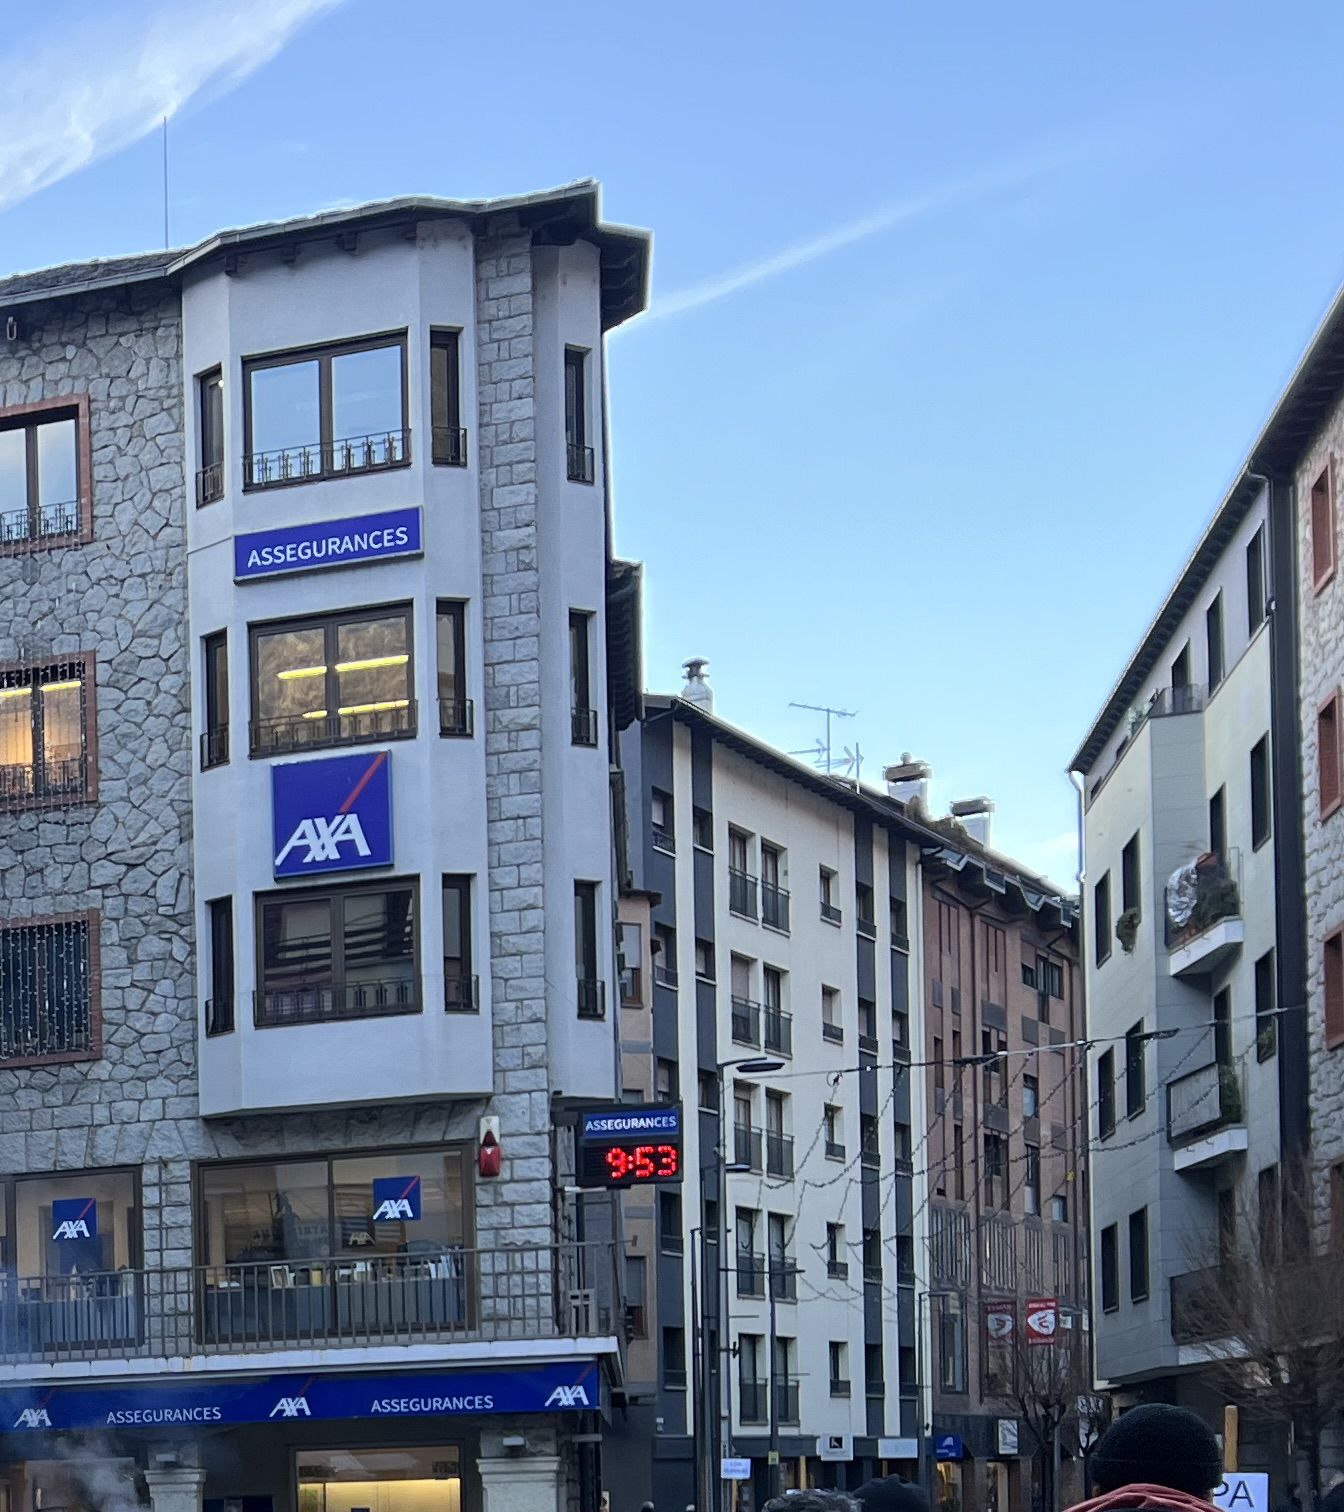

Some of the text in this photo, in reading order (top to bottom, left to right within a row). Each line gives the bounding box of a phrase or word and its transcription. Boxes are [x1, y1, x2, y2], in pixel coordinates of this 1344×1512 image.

[247, 527, 408, 568] ASSEGURANCES
[275, 813, 371, 866] AXA
[585, 1115, 677, 1132] ASSEGURANCES
[606, 1145, 677, 1178] 9:53
[373, 1199, 413, 1220] AXA
[52, 1219, 91, 1240] AXA
[14, 1408, 52, 1428] AXA
[106, 1406, 222, 1425] ASSEGURANCES
[269, 1397, 312, 1418] AXA
[370, 1395, 494, 1413] ASSEGURANCES
[544, 1385, 590, 1406] AXA
